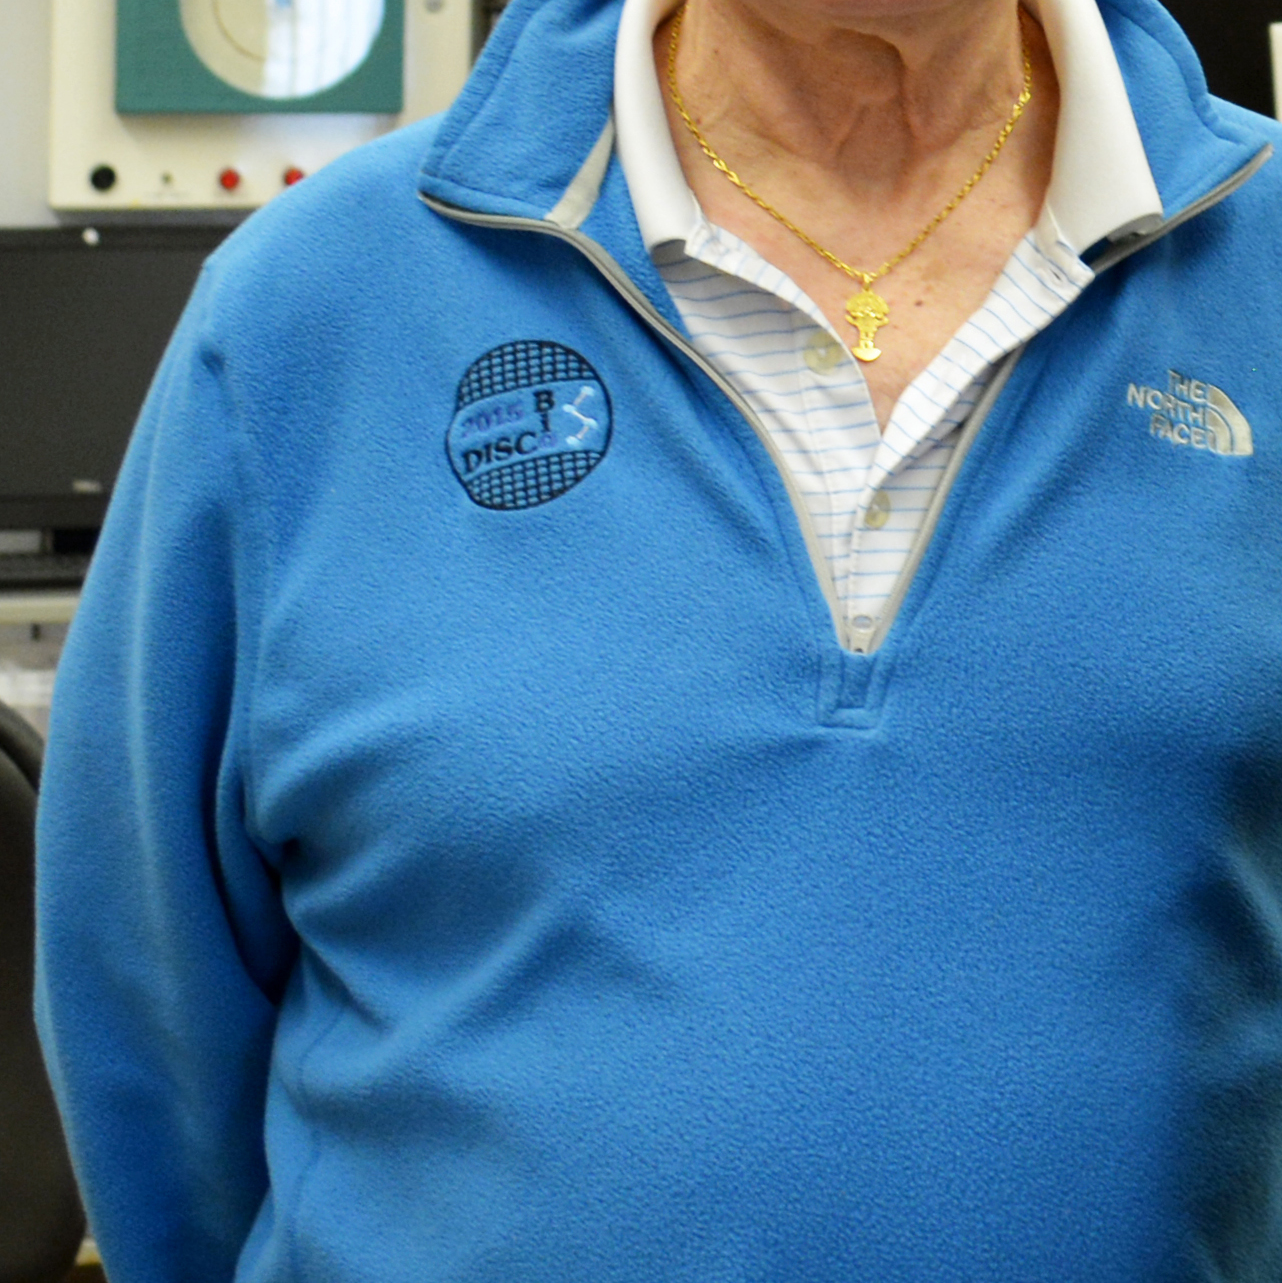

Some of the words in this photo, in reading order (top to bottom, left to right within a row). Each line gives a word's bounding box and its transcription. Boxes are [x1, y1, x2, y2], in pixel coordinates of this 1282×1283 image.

[1168, 368, 1206, 402] THE
[461, 402, 525, 439] 2015
[1127, 382, 1206, 427] NORTH
[1150, 412, 1207, 449] FACE
